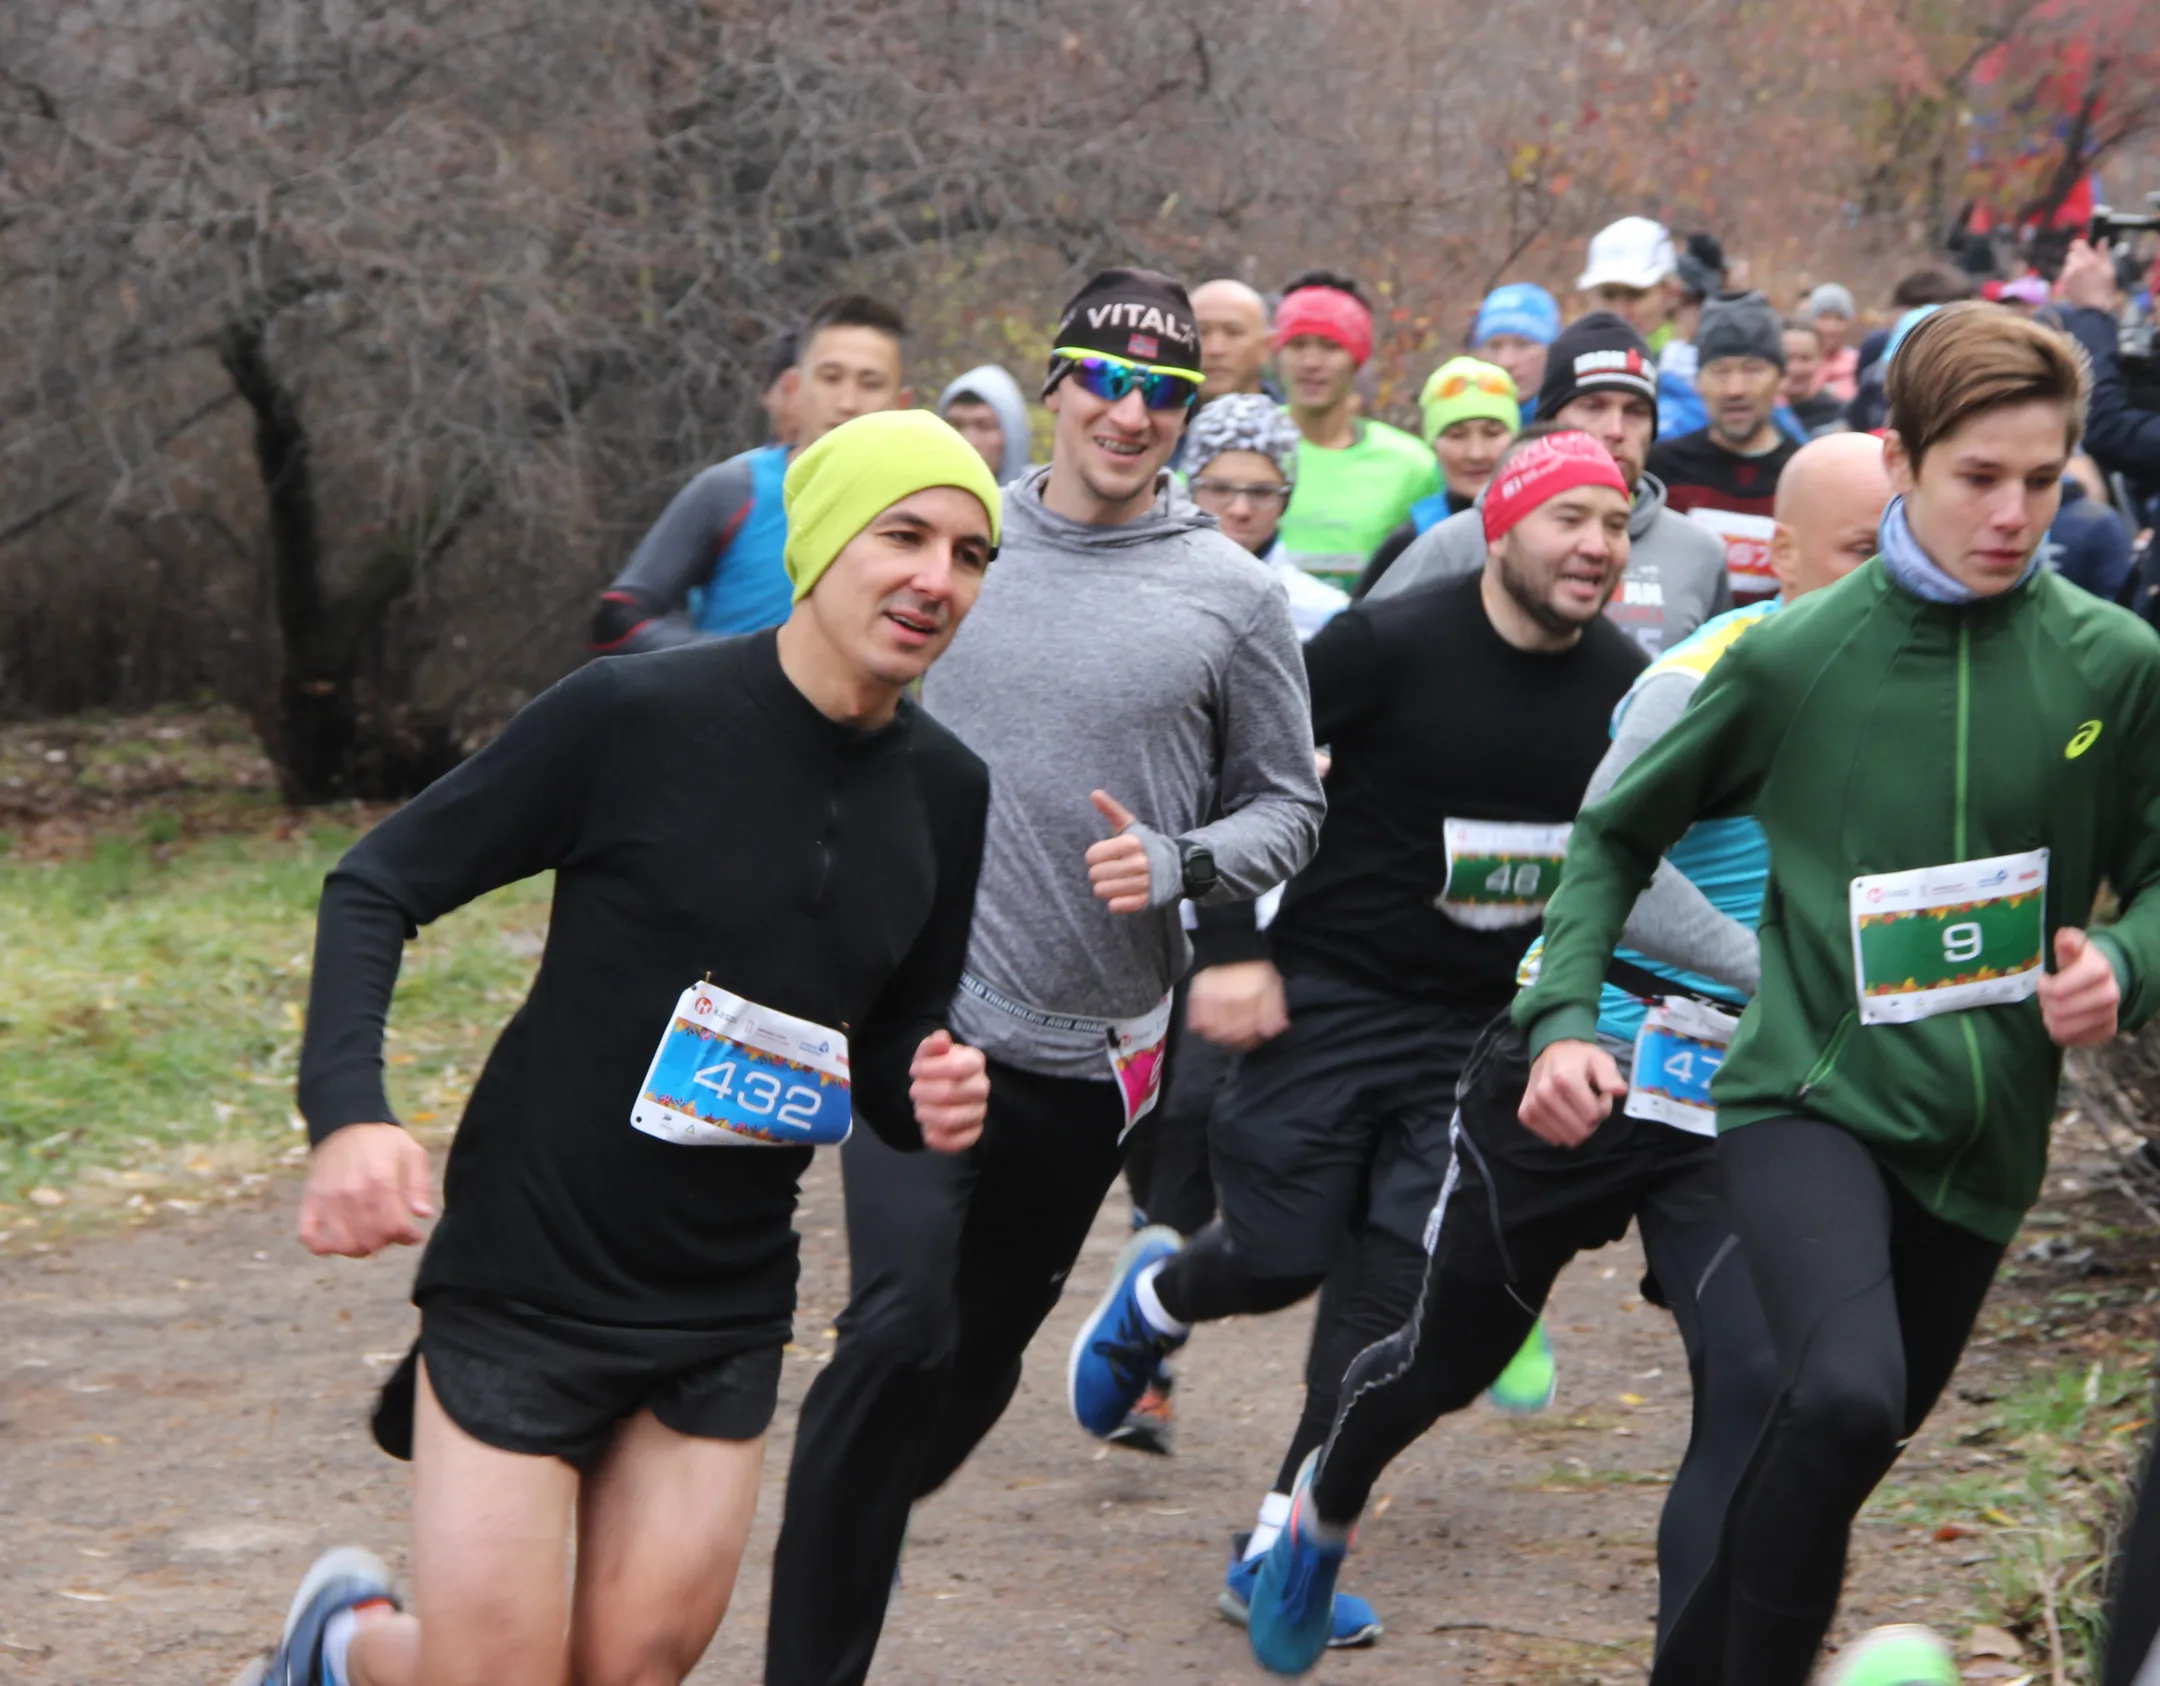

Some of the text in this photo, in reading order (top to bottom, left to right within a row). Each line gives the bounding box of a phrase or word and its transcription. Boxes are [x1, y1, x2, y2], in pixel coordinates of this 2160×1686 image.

[1086, 303, 1181, 342] VITAL
[1942, 921, 1983, 963] 9
[692, 1061, 822, 1131] 432
